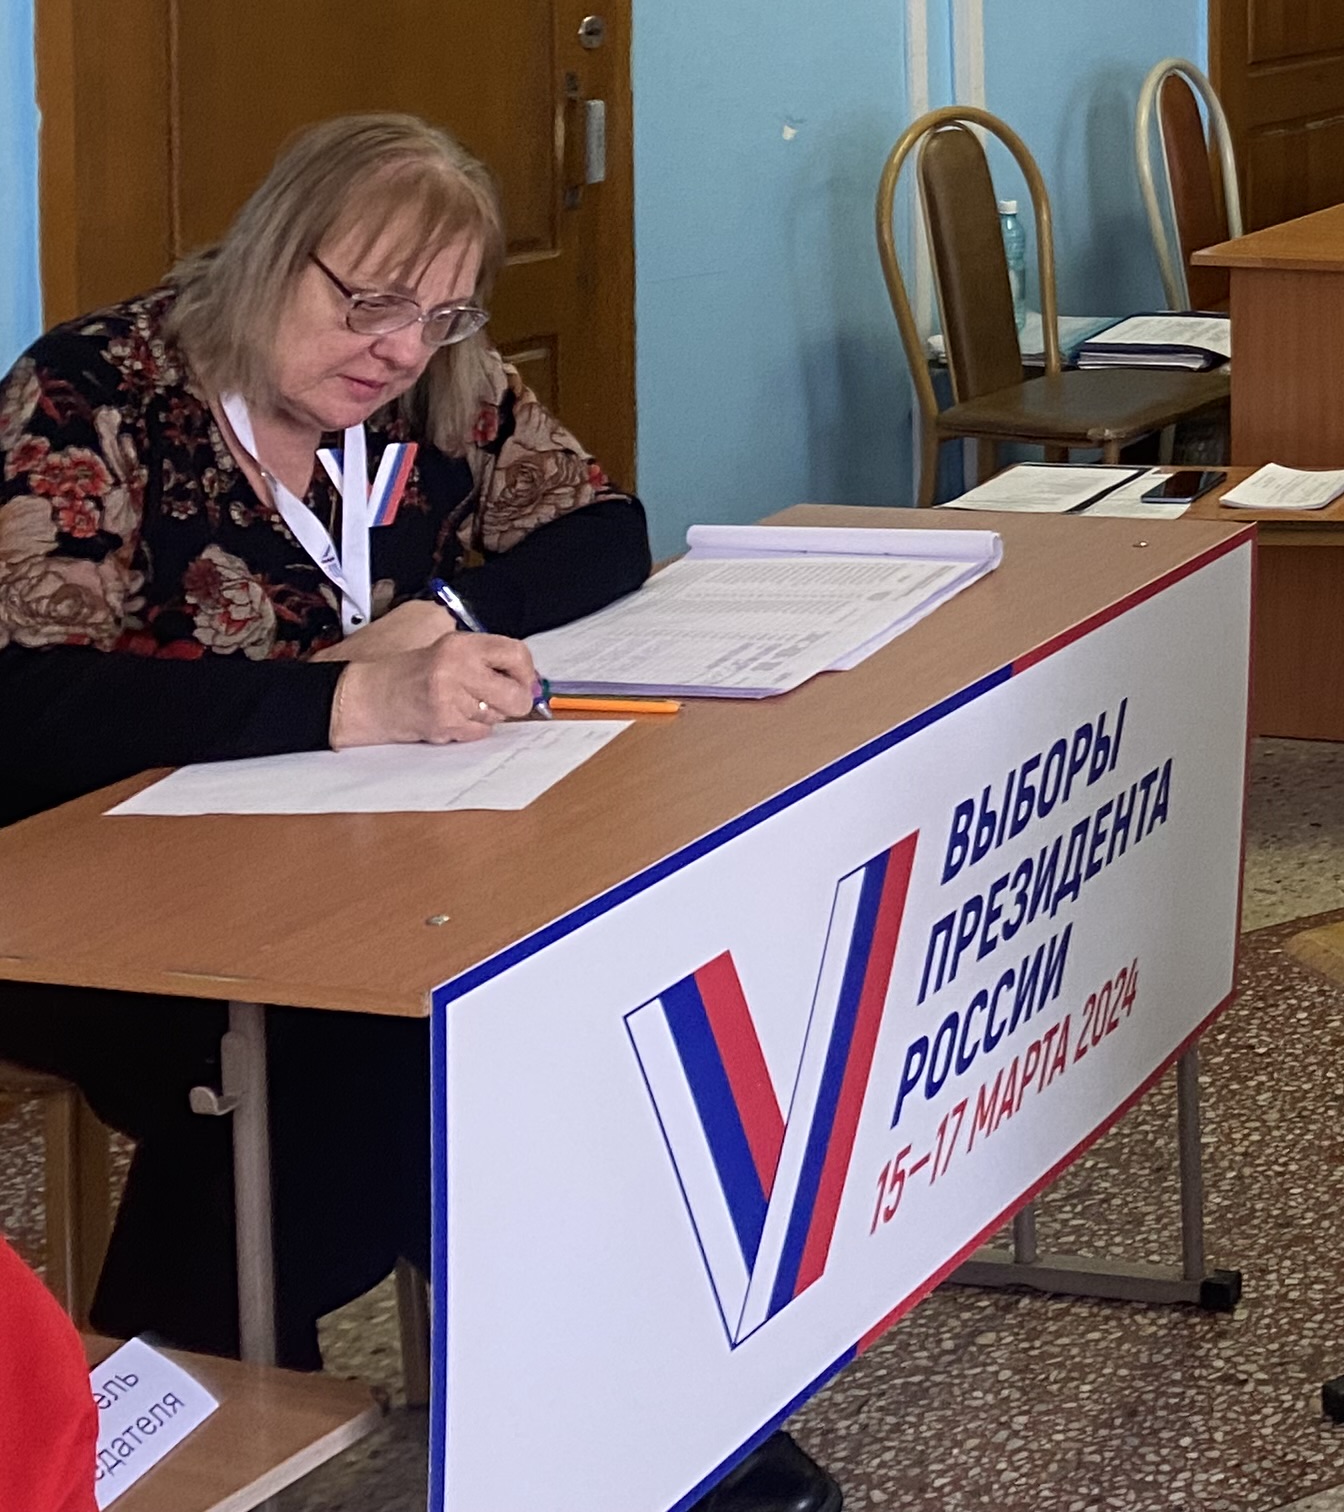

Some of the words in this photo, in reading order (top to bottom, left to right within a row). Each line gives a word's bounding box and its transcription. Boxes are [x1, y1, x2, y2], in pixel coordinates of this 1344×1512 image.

[916, 757, 1174, 1007] ПРЕЗИДЕНТА
[940, 696, 1128, 886] ВЫБОРЫ
[889, 922, 1074, 1130] РОССИИ
[965, 1013, 1072, 1155] МАРТА
[1072, 956, 1140, 1065] 2024
